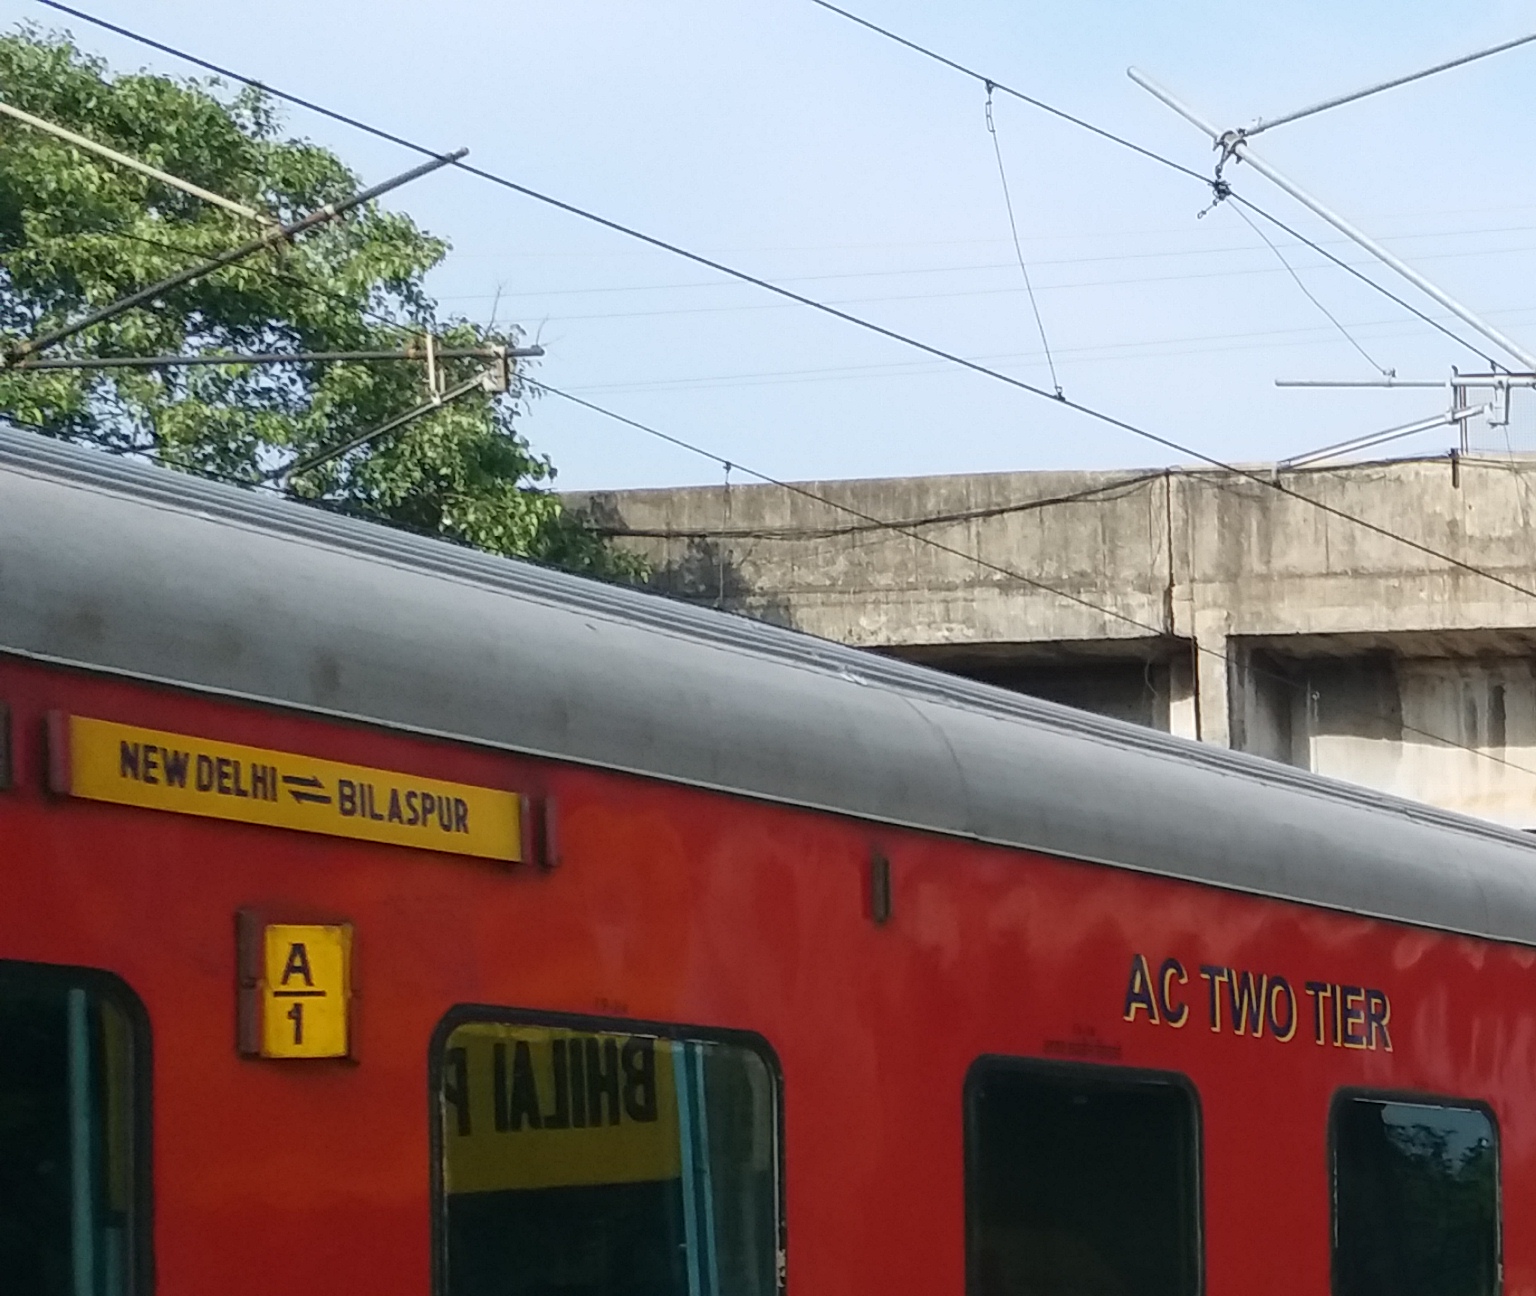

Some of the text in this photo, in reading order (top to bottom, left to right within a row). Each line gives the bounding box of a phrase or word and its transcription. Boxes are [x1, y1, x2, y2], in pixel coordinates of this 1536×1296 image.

[119, 740, 470, 834] NEW DELHI BILASPUR
[281, 942, 314, 987] A
[287, 1002, 303, 1045] 1
[1123, 953, 1189, 1029] AC
[1200, 964, 1298, 1043] TWO
[1305, 981, 1394, 1052] TIER
